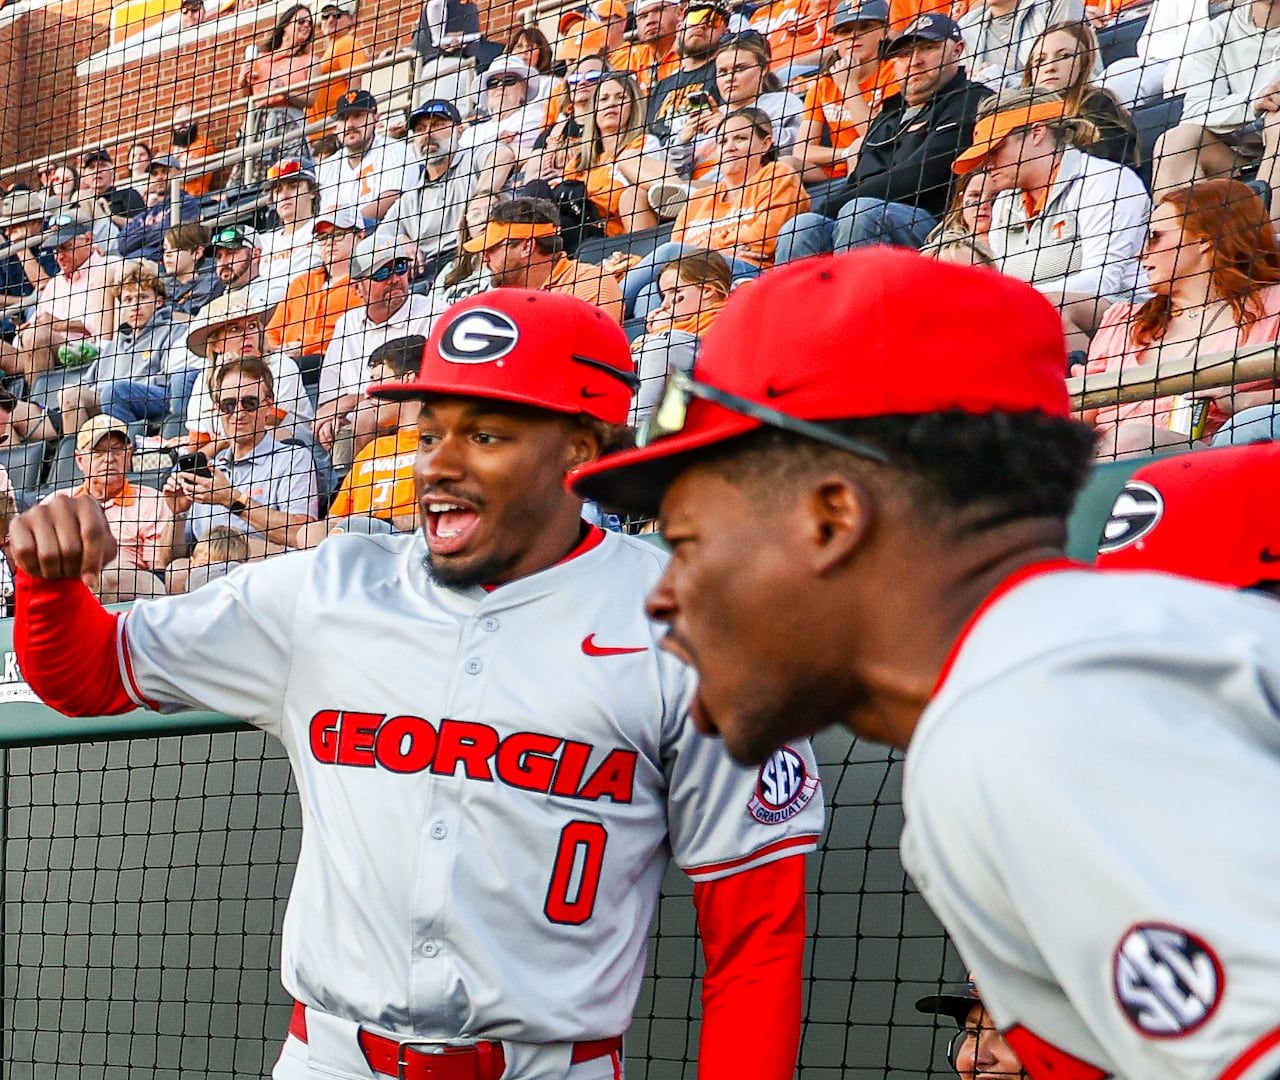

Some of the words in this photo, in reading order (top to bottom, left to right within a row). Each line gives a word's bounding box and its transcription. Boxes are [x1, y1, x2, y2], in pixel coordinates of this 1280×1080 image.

[438, 307, 519, 364] G
[309, 708, 638, 805] GEORGIA
[761, 750, 802, 806] SEC
[755, 791, 810, 823] GRADUATE
[544, 820, 606, 926] 0
